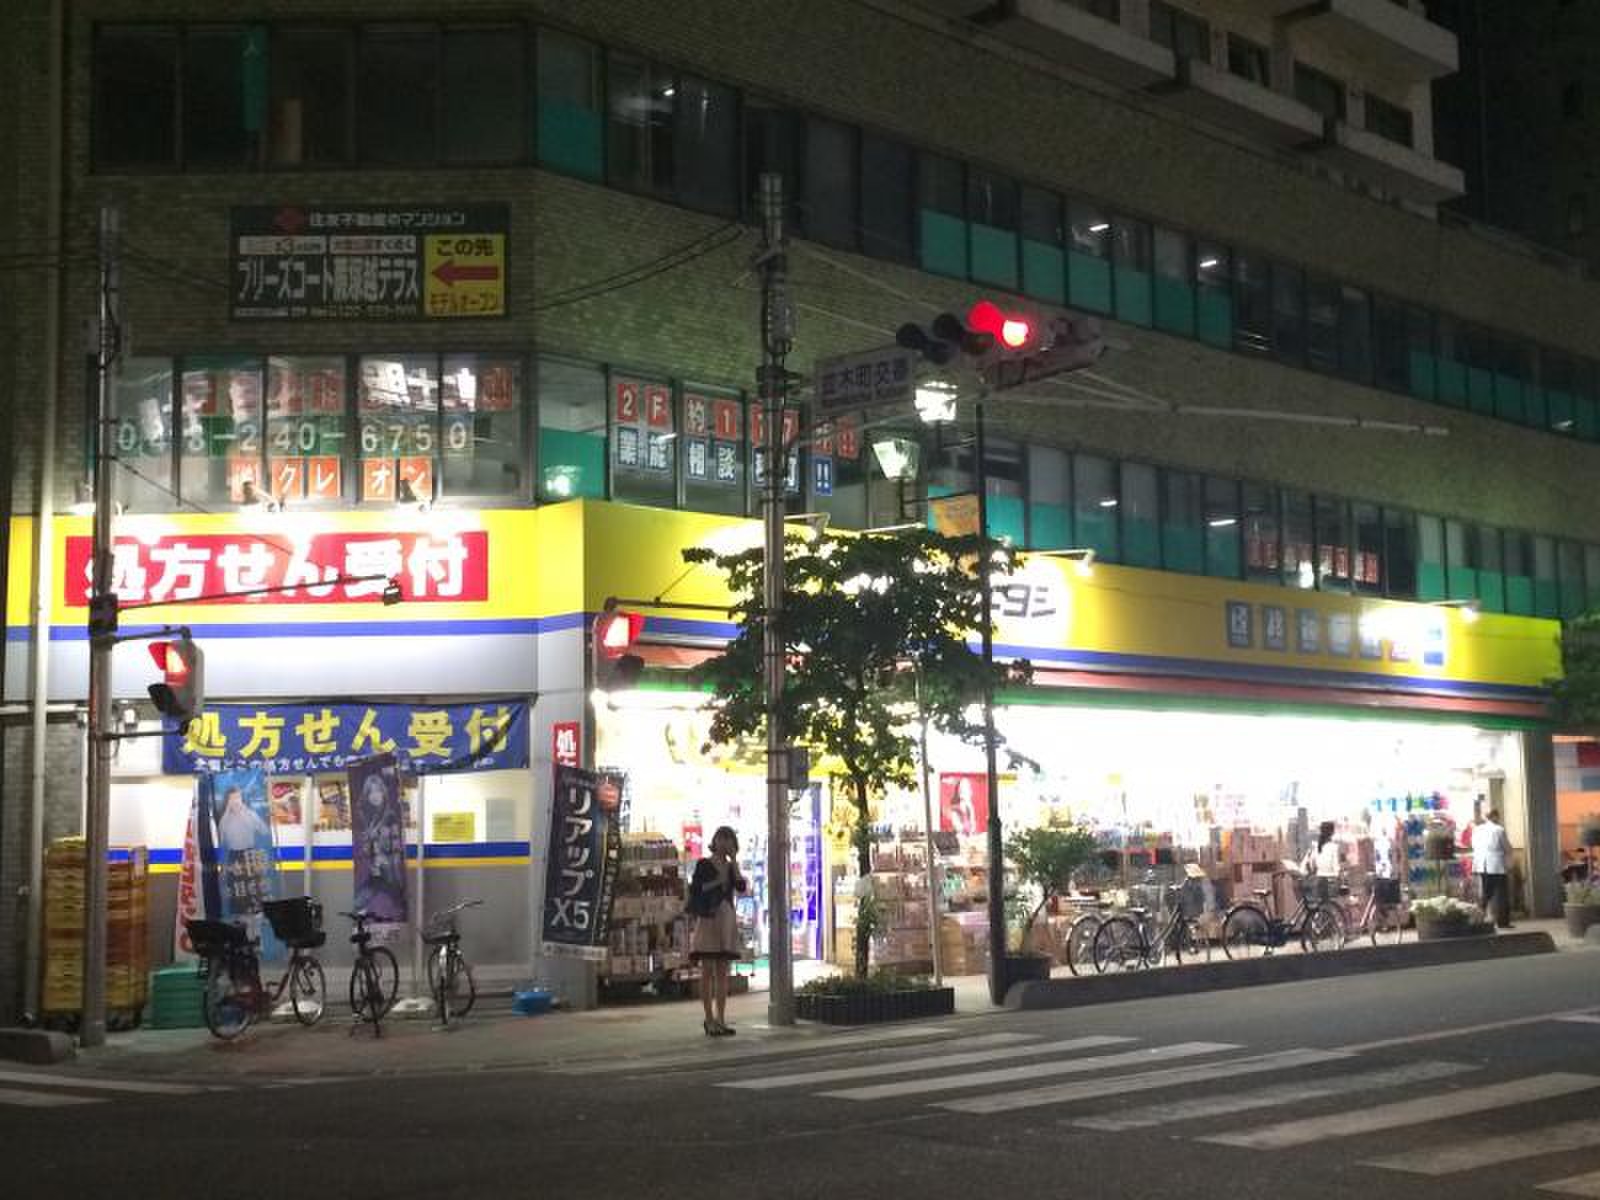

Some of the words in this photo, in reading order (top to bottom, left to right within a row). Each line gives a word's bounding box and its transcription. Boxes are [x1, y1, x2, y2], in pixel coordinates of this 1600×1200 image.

[183, 708, 512, 759] 処方せん受付
